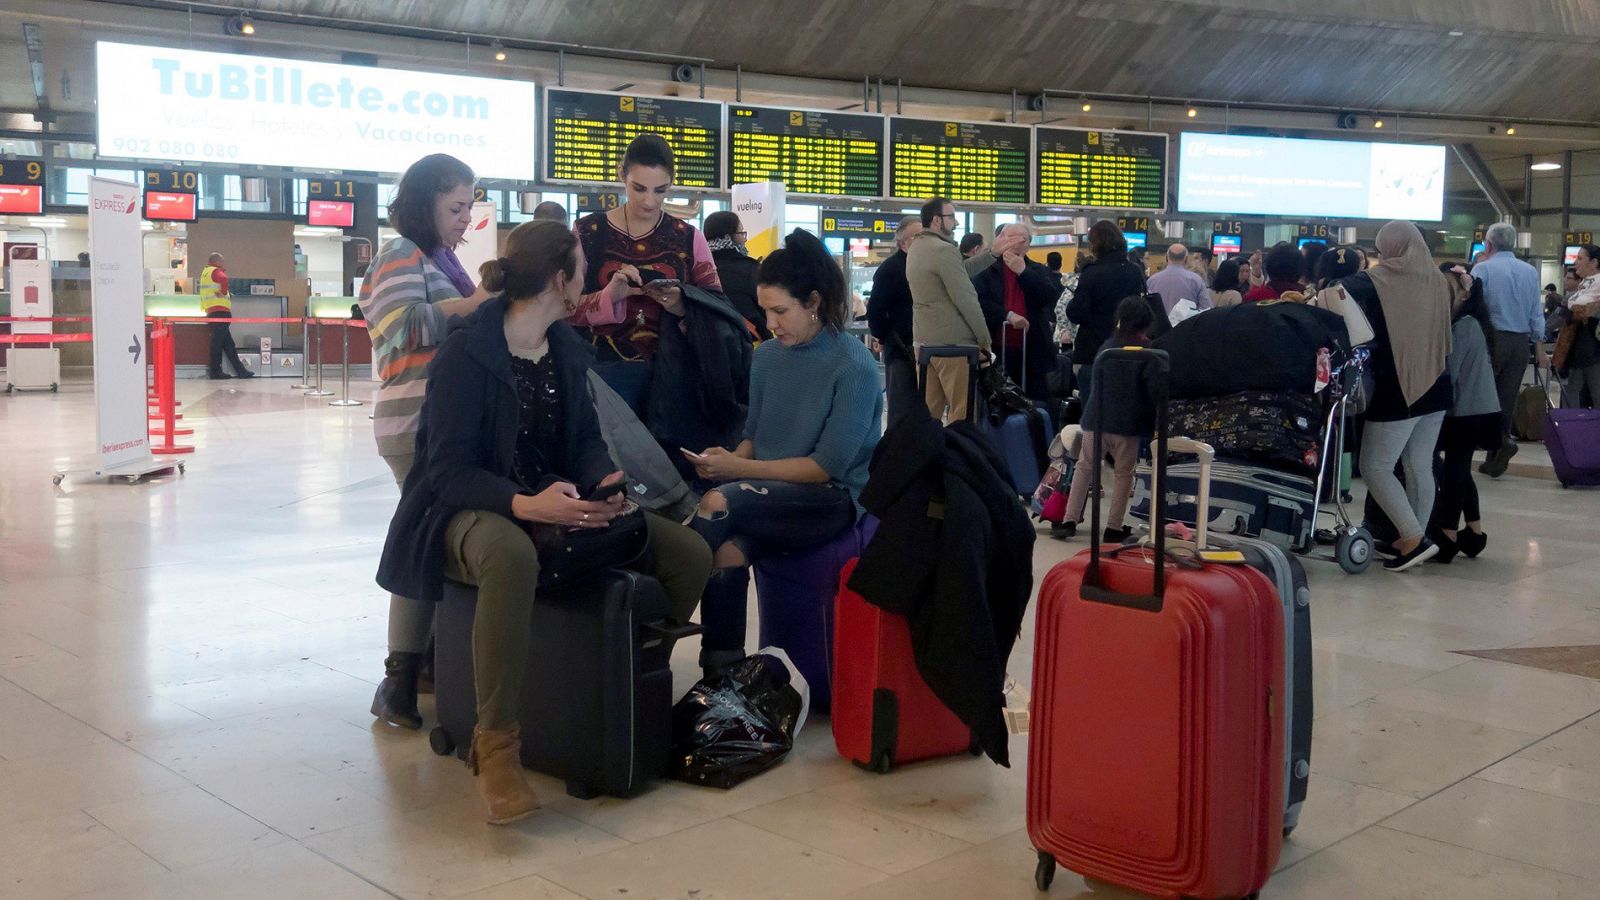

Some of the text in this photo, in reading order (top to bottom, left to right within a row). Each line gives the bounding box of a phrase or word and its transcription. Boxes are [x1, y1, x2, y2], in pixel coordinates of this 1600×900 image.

[152, 58, 489, 119] TuBillete.com
[354, 121, 487, 148] Vacaciones
[113, 137, 239, 158] 902 080 080
[27, 162, 41, 180] 9
[171, 172, 196, 189] 10
[334, 181, 355, 198] 11
[474, 189, 485, 202] 2
[94, 198, 126, 213] EXPRESS
[598, 194, 617, 209] 13
[737, 200, 762, 213] vueling
[1133, 217, 1148, 231] 14
[1228, 221, 1242, 234] 15
[1313, 225, 1326, 237] 16
[1578, 233, 1591, 244] 19
[102, 438, 143, 453] iberiaexpress.com
